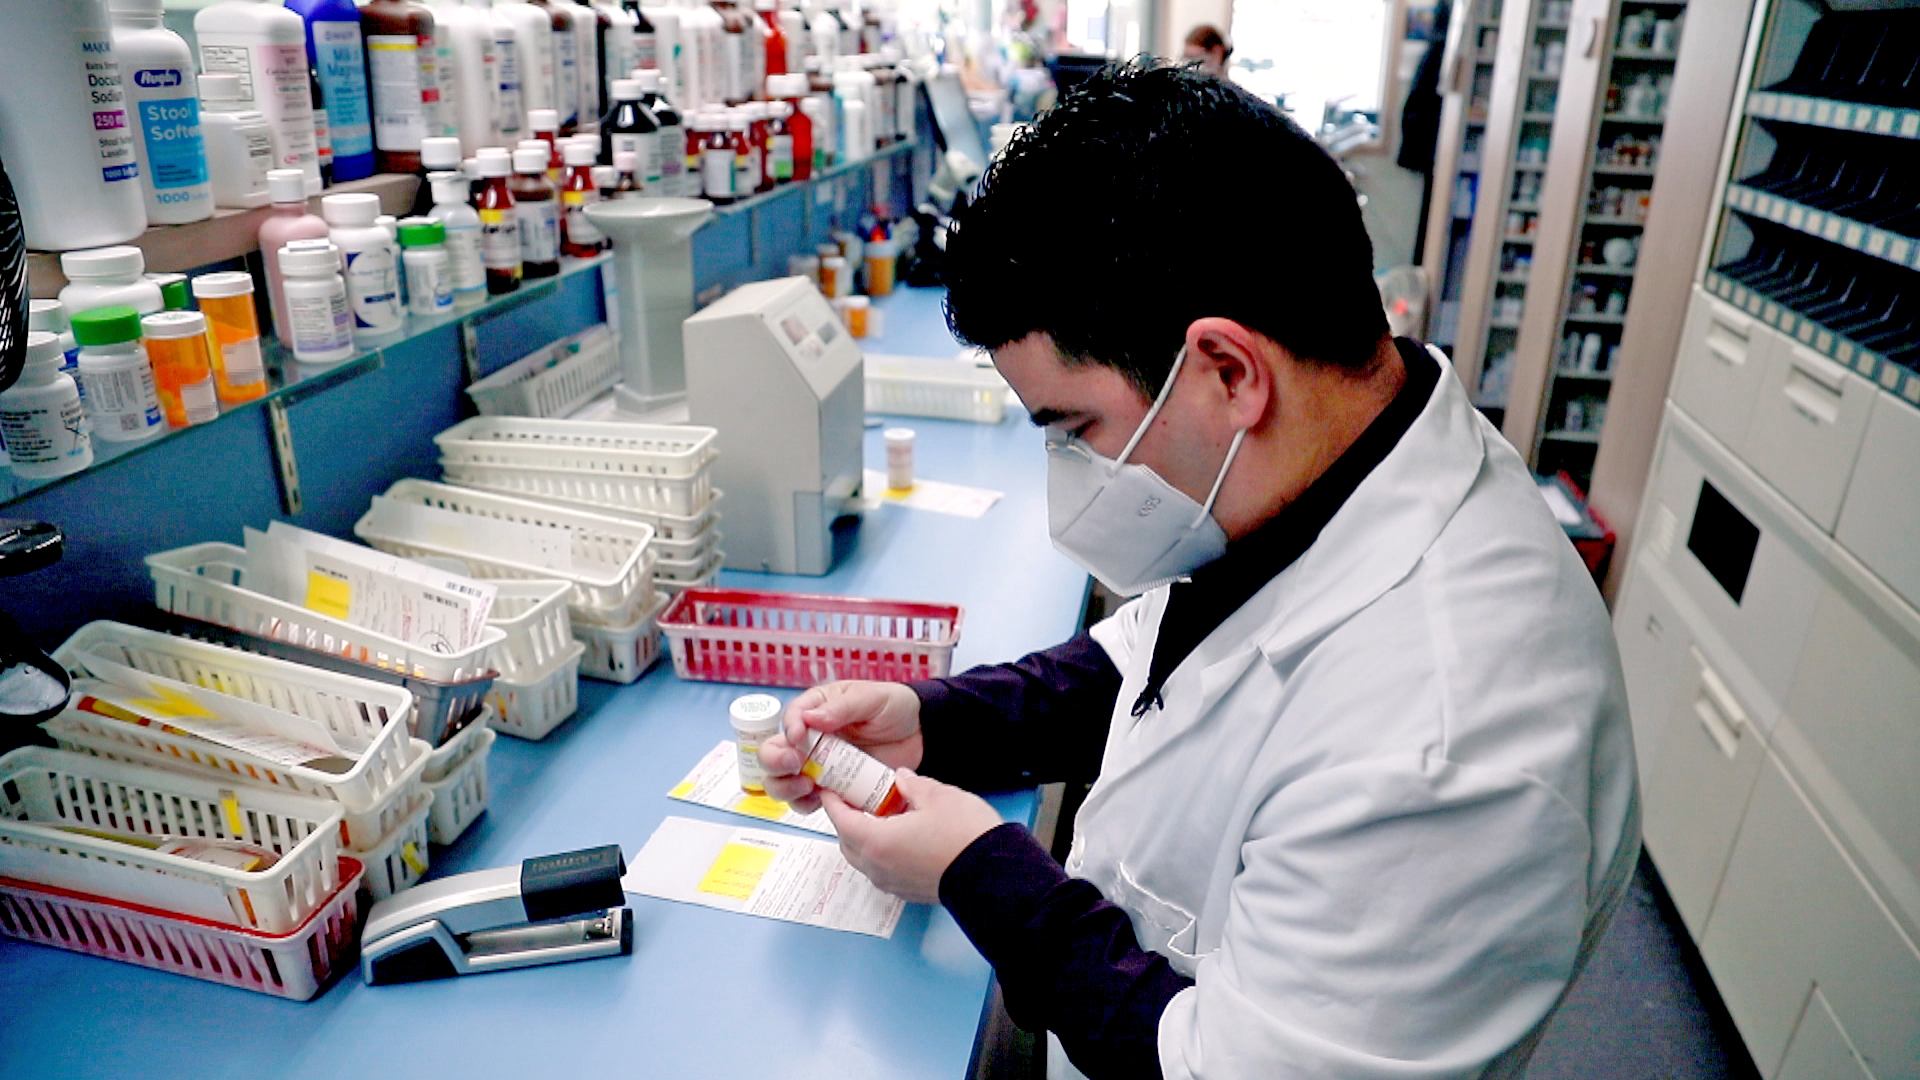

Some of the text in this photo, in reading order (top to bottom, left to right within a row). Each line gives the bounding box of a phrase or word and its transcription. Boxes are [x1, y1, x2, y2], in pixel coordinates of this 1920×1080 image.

[141, 68, 179, 87] Rugby
[147, 102, 192, 121] Stool
[96, 114, 115, 127] 250
[156, 191, 189, 204] 1000
